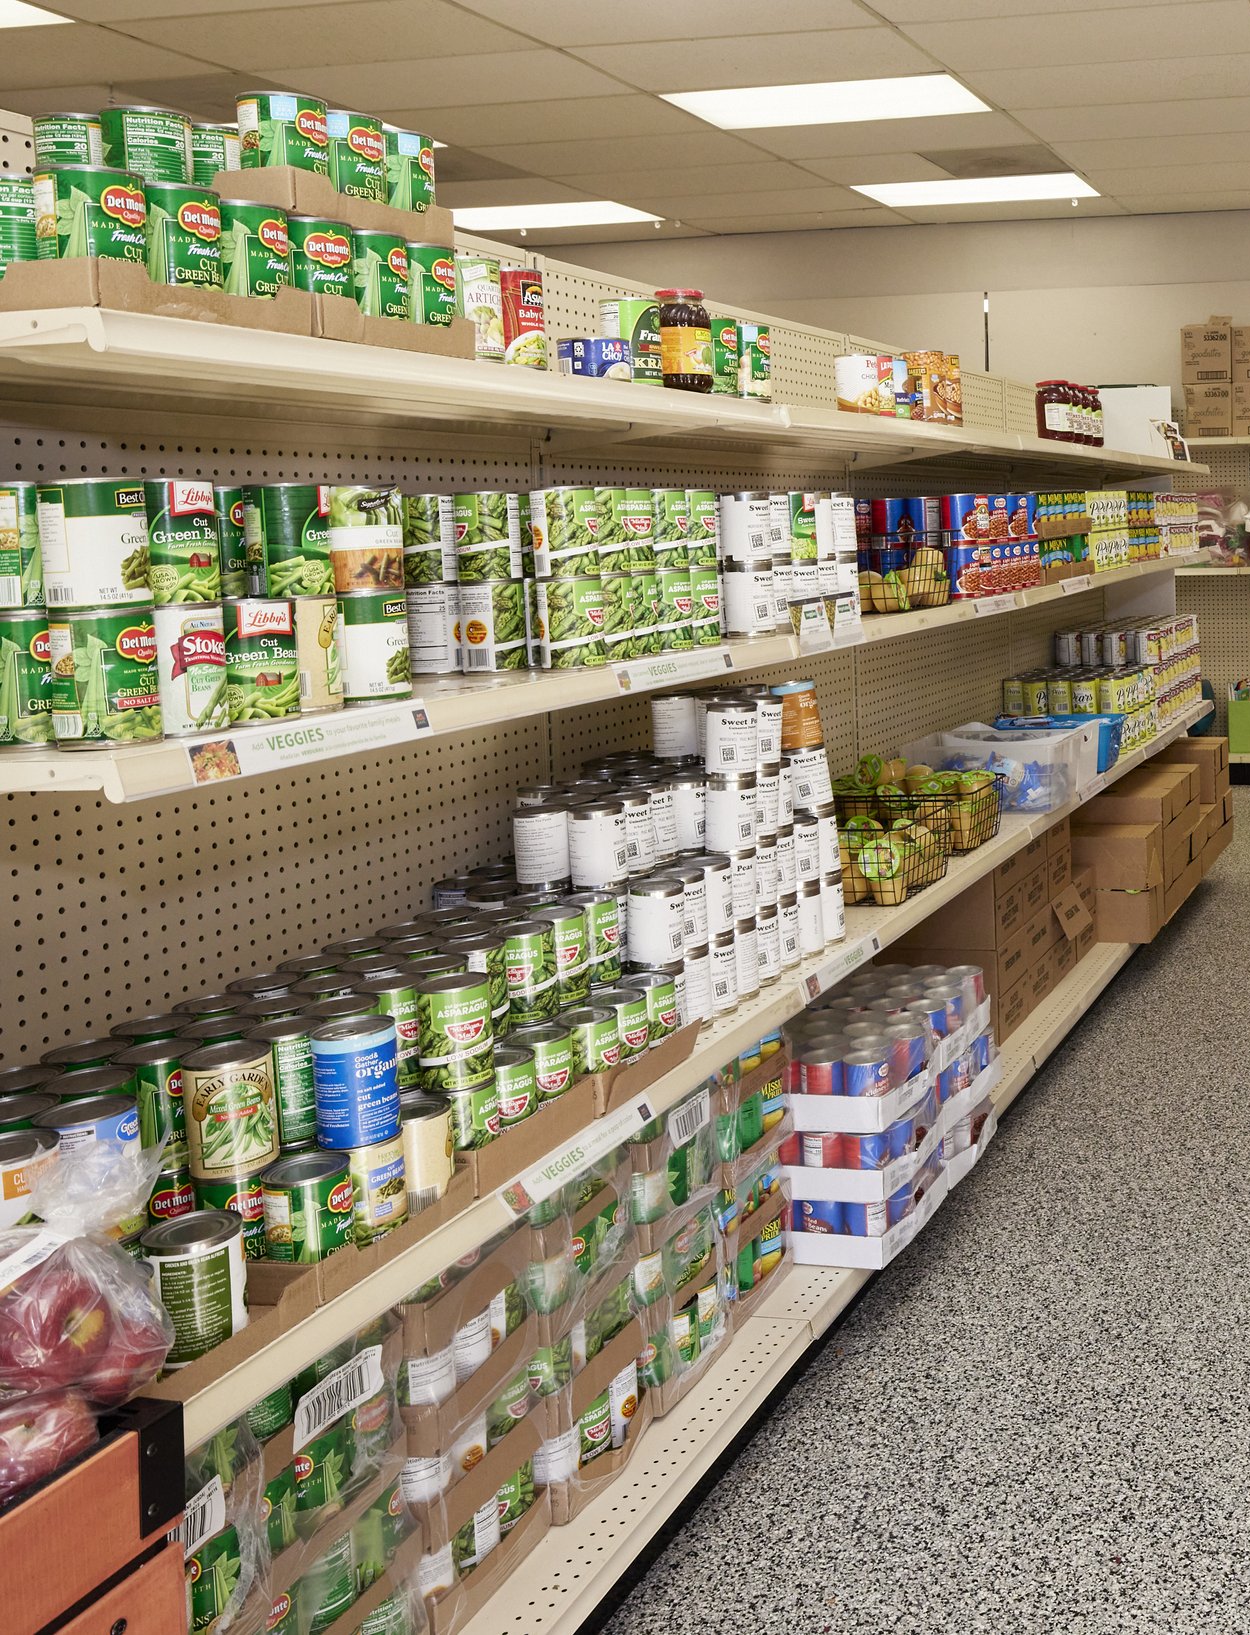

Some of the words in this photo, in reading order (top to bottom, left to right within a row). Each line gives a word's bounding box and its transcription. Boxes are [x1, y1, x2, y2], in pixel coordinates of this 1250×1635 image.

[62, 123, 86, 131] Facts
[126, 117, 163, 126] Nutrition
[165, 119, 184, 129] Facts
[127, 137, 159, 145] Calories
[345, 185, 374, 197] GREEN
[106, 194, 125, 208] Del
[122, 210, 141, 221] Quality
[183, 211, 202, 224] Del
[91, 221, 120, 230] MADE
[169, 235, 197, 244] MADE
[124, 246, 143, 258] CUT
[308, 241, 325, 252] Del
[326, 243, 349, 255] Monte
[199, 258, 218, 270] CUT
[323, 253, 341, 263] Quality
[175, 267, 210, 281] GREEN
[519, 310, 538, 322] Baby
[602, 342, 613, 352] LA
[602, 350, 622, 361] CHOY
[118, 491, 139, 505] Best
[181, 487, 212, 506] Libby's
[193, 517, 208, 527] Cut
[153, 529, 199, 543] Green
[248, 610, 287, 628] Libby's
[122, 638, 138, 649] Del
[183, 637, 225, 655] Stoke
[260, 638, 278, 647] Cut
[224, 648, 269, 664] Green
[648, 662, 677, 677] VEGGIES
[140, 678, 155, 686] CUT
[118, 687, 148, 697] GREEN
[266, 728, 324, 751] VEGGIES
[794, 756, 816, 765] Sweet
[437, 1000, 488, 1019] ASPARAGUS
[197, 1078, 226, 1107] EARLY
[230, 1072, 270, 1091] GARDEN
[210, 1105, 227, 1113] Mixed
[358, 1098, 380, 1111] green
[542, 1147, 585, 1180] VEGGIES
